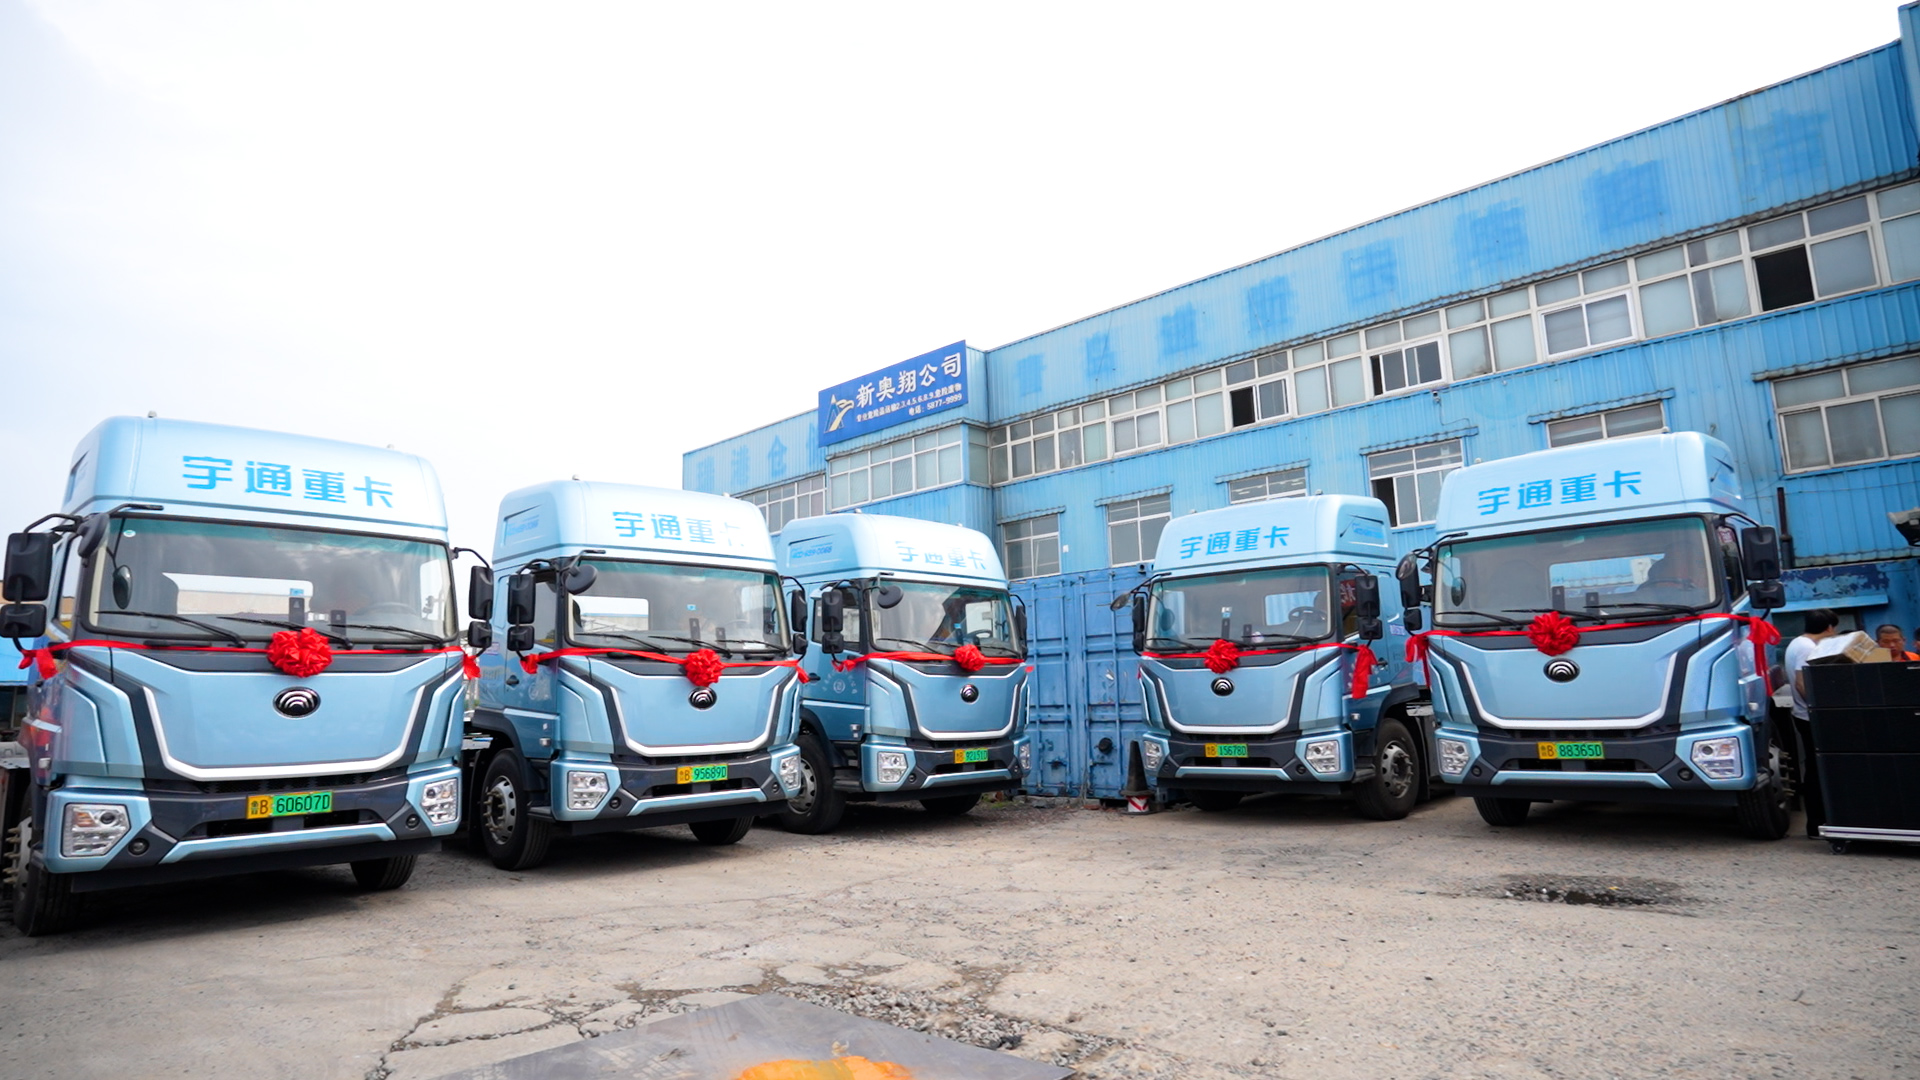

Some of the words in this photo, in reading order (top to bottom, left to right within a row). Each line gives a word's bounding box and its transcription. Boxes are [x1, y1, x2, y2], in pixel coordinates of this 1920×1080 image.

[856, 352, 962, 409] 新奥翔公司
[182, 455, 393, 509] 宇通重卡
[1477, 470, 1642, 516] 宇通重卡
[613, 511, 744, 547] 宇通重卡
[1180, 526, 1290, 559] 宇通重卡
[895, 541, 987, 570] 宇通重卡
[1559, 744, 1602, 757] 88365D
[694, 766, 727, 780] 95689D
[276, 794, 331, 813] 60607D
